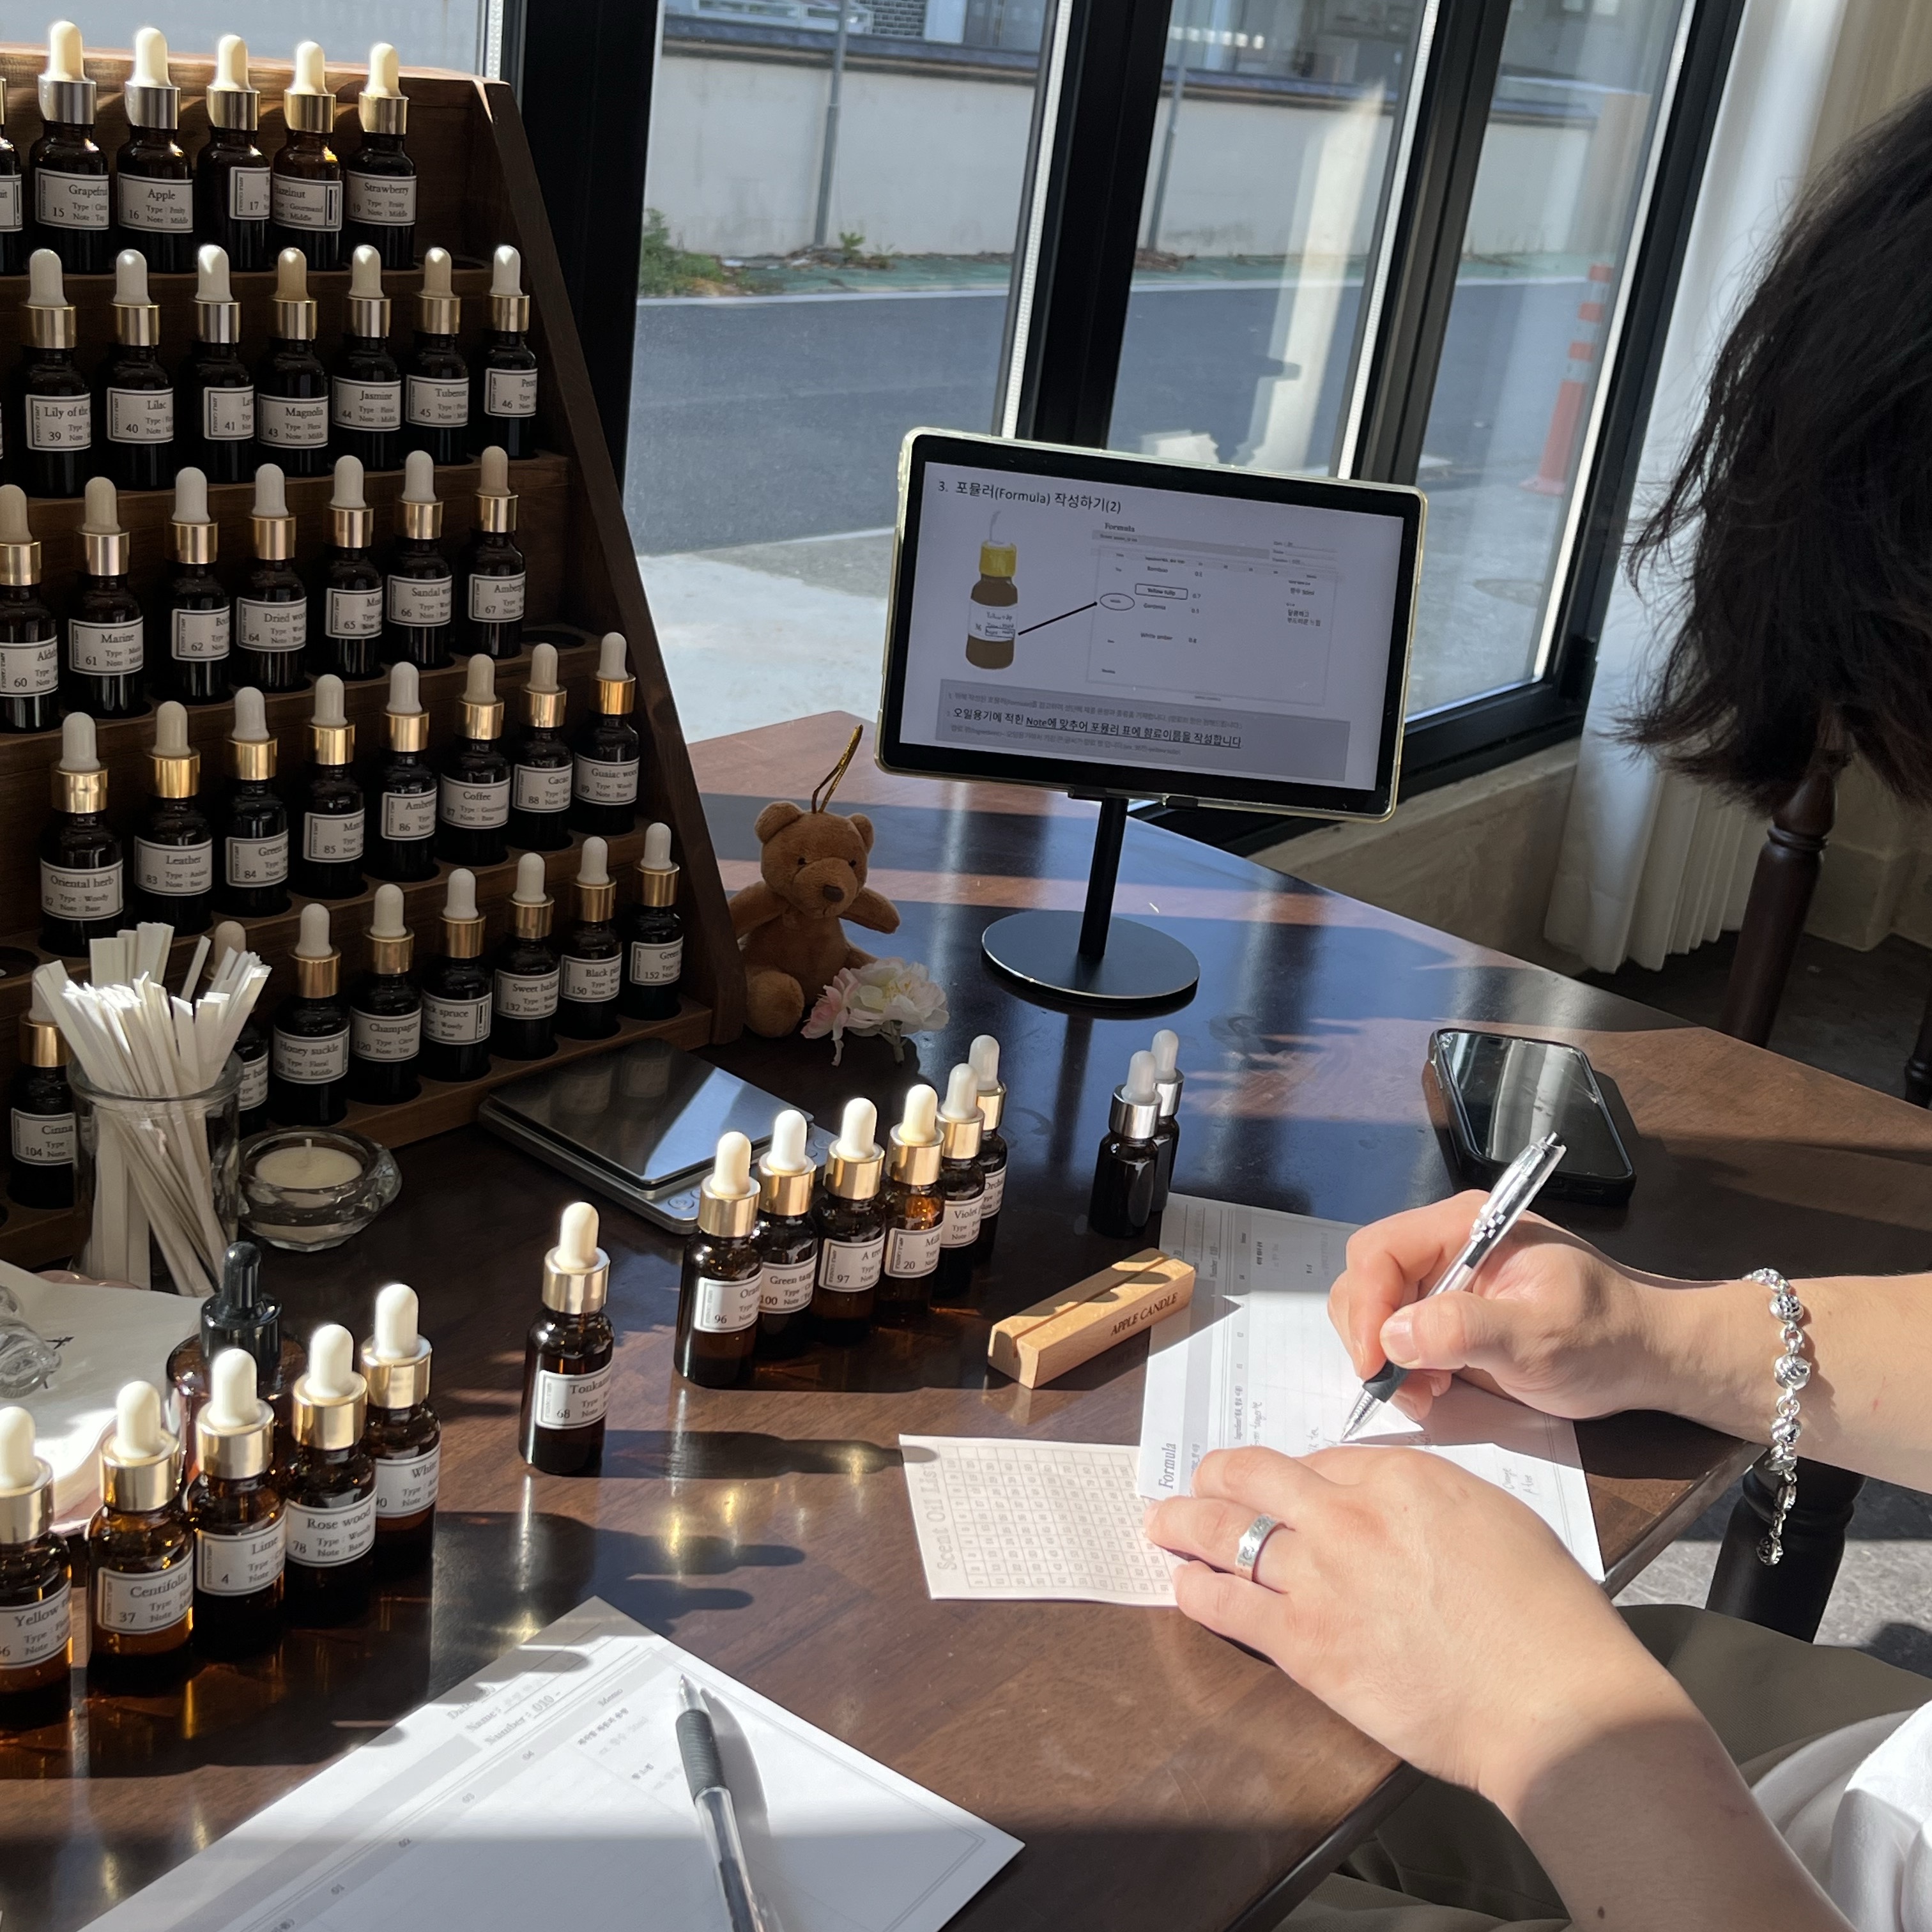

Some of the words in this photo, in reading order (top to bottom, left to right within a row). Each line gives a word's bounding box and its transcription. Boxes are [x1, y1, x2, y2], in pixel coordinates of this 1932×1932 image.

[364, 183, 409, 195] Strawberry
[148, 189, 176, 201] Apple
[249, 202, 258, 210] 17
[52, 207, 65, 218] 15
[129, 210, 139, 219] 16
[502, 400, 513, 408] 46
[44, 406, 64, 418] Lily
[67, 406, 77, 417] of
[342, 410, 351, 418] 44
[420, 409, 431, 417] 45
[126, 424, 139, 433] 40
[225, 422, 235, 431] 41
[49, 432, 62, 441] 39
[268, 428, 279, 437] 43
[938, 480, 949, 493] 3.
[956, 480, 1050, 506] 포뮬러(Formula)
[1054, 492, 1121, 514] 작성하기(2)
[411, 587, 440, 597] Sandal
[264, 613, 289, 623] Dried
[401, 609, 412, 617] 66
[344, 621, 355, 630] 65
[249, 632, 260, 641] 64
[191, 642, 203, 651] 62
[86, 656, 96, 666] 61
[14, 678, 27, 687] 60
[954, 708, 1002, 723] 오일용기에
[1026, 717, 1057, 729] Note에
[1059, 719, 1087, 732] 맞추어
[1091, 722, 1119, 734] 포뮬러
[1123, 725, 1141, 737] 표에
[1194, 732, 1241, 747] 작성합니다
[581, 785, 590, 793] 89
[463, 791, 491, 801] Coffee
[528, 796, 539, 804] 88
[399, 823, 411, 831] 86
[258, 845, 282, 857] Green
[324, 845, 336, 854] 85
[165, 855, 202, 865] Leather
[146, 875, 158, 884] 83
[244, 870, 256, 879] 84
[50, 875, 90, 888] Oriental
[93, 875, 114, 887] herb
[586, 968, 608, 977] Black
[645, 971, 660, 979] 152
[512, 983, 537, 993] Sweet
[572, 986, 587, 995] 150
[505, 1002, 521, 1011] 132
[440, 1008, 469, 1018] spruce
[280, 1041, 308, 1056] Honey
[310, 1044, 339, 1055] suckle
[356, 1041, 371, 1052] 120
[25, 1146, 42, 1157] 104
[903, 1261, 916, 1269] 20
[770, 1275, 797, 1285] Green
[837, 1275, 850, 1284] 97
[760, 1294, 778, 1305] 100
[714, 1314, 727, 1324] 96
[1110, 1313, 1138, 1337] APPLE
[1140, 1292, 1177, 1321] CANDLE
[556, 1409, 571, 1418] 68
[1158, 1442, 1177, 1490] Formula
[924, 1498, 946, 1523] Oil
[307, 1517, 339, 1529] Rose
[342, 1505, 371, 1526] wood
[251, 1536, 279, 1555] Lime
[293, 1540, 307, 1554] 78
[317, 1537, 339, 1547] Type
[935, 1526, 958, 1570] Scent
[220, 1574, 229, 1584] 4
[130, 1574, 188, 1598] Centifolia
[148, 1600, 172, 1612] Type
[14, 1605, 59, 1628] Yellow
[119, 1612, 136, 1623] 37
[24, 1631, 48, 1644] Type
[25, 1643, 49, 1655] Note
[484, 1715, 526, 1745] Number
[531, 1694, 555, 1713] 010
